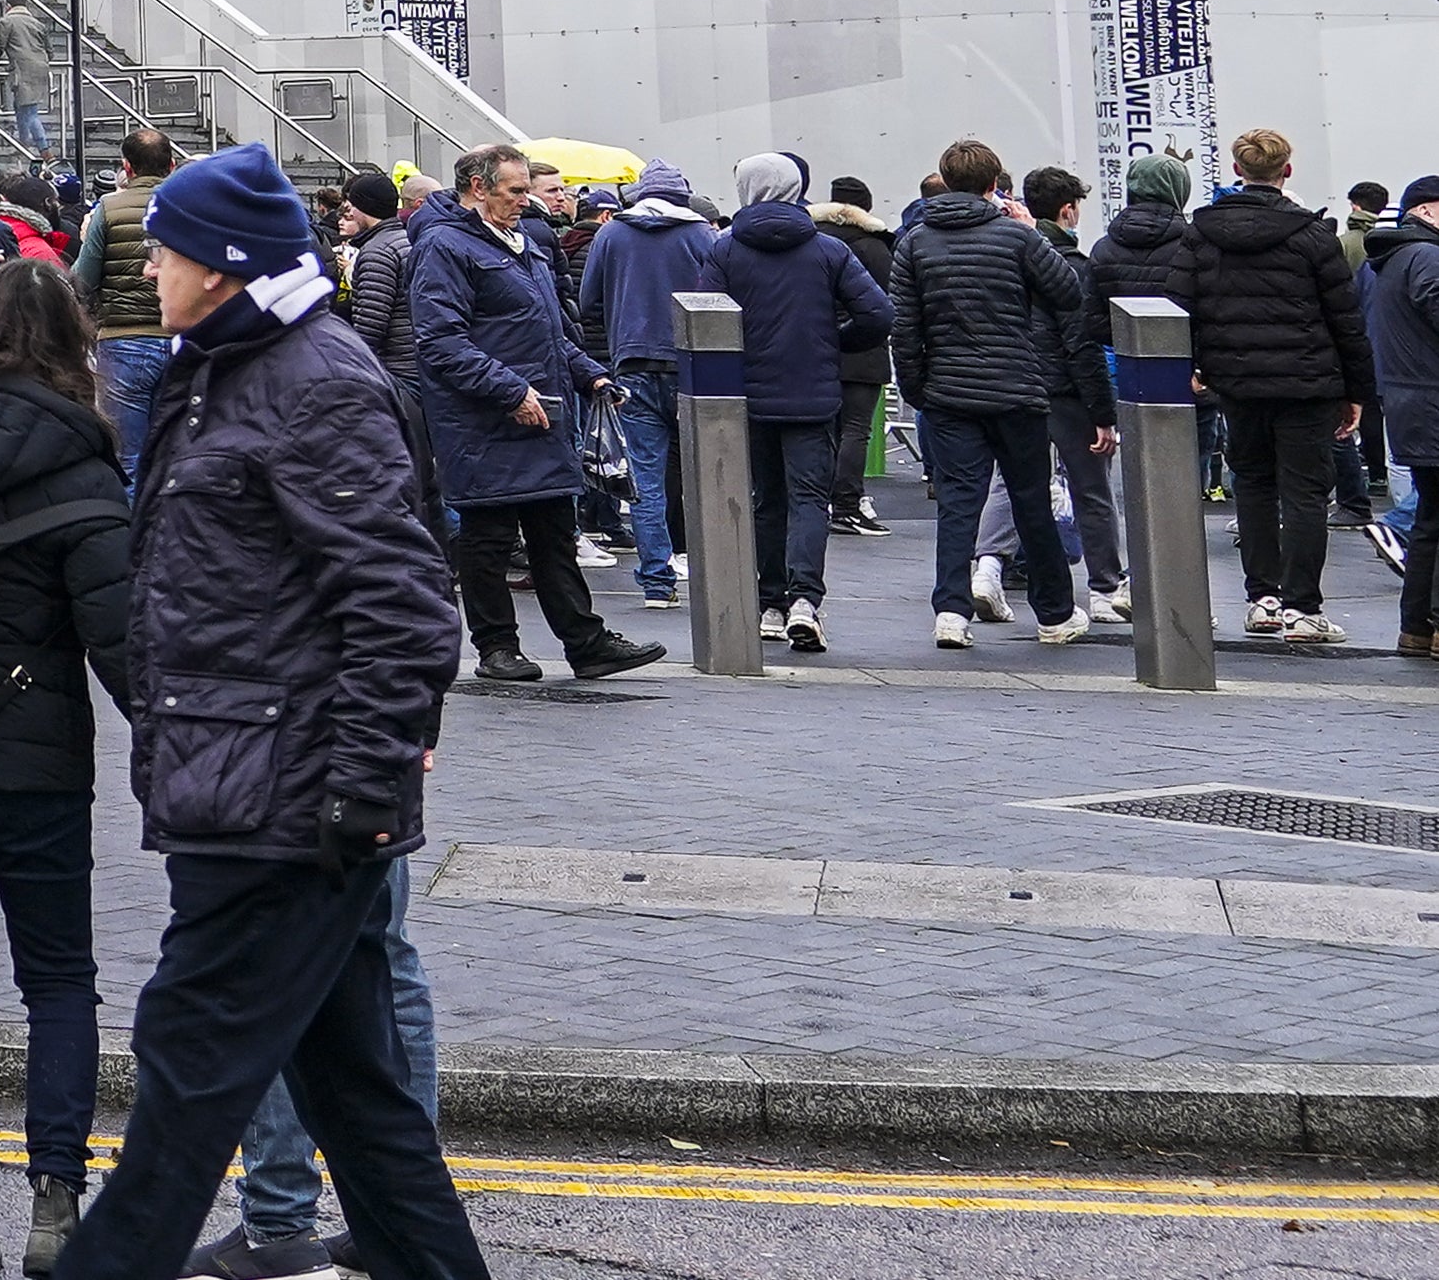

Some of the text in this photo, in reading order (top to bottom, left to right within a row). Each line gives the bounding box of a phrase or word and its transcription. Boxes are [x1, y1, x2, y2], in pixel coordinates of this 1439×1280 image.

[399, 2, 452, 19] WITAMY
[1176, 0, 1195, 67] VÍTEJTE
[1124, 82, 1153, 157] WELC
[1184, 71, 1196, 119] WITAMY
